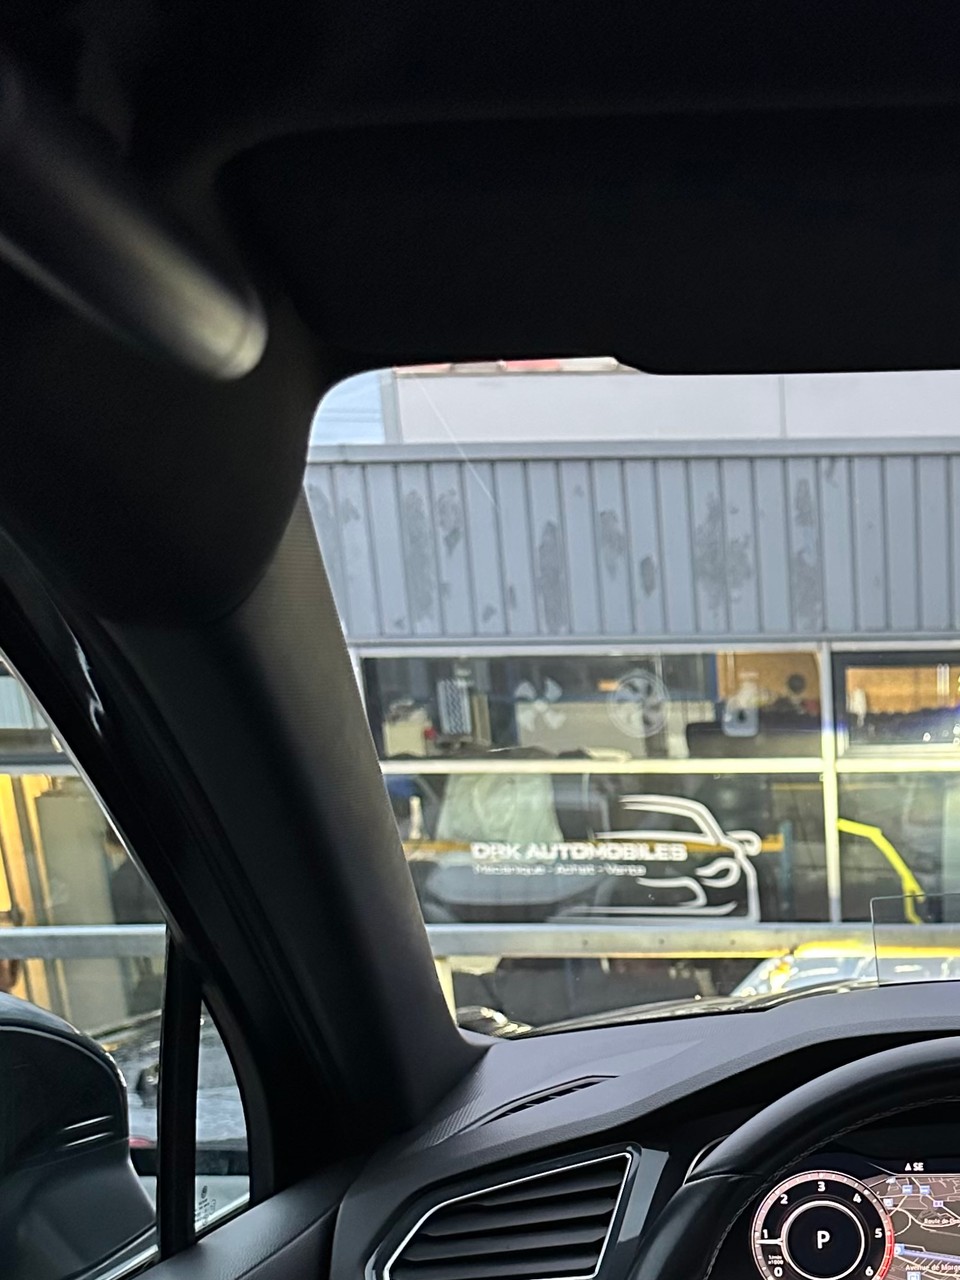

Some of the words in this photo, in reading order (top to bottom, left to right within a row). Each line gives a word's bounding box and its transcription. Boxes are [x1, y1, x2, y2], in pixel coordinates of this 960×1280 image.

[525, 841, 688, 861] AUTOMOBILES
[913, 1162, 924, 1172] SE
[817, 1181, 826, 1192] 3
[780, 1194, 788, 1204] 2
[853, 1193, 862, 1203] 4
[762, 1229, 768, 1239] 1
[874, 1228, 883, 1238] 5
[816, 1230, 830, 1249] P
[773, 1266, 783, 1277] 0
[865, 1266, 874, 1276] 6
